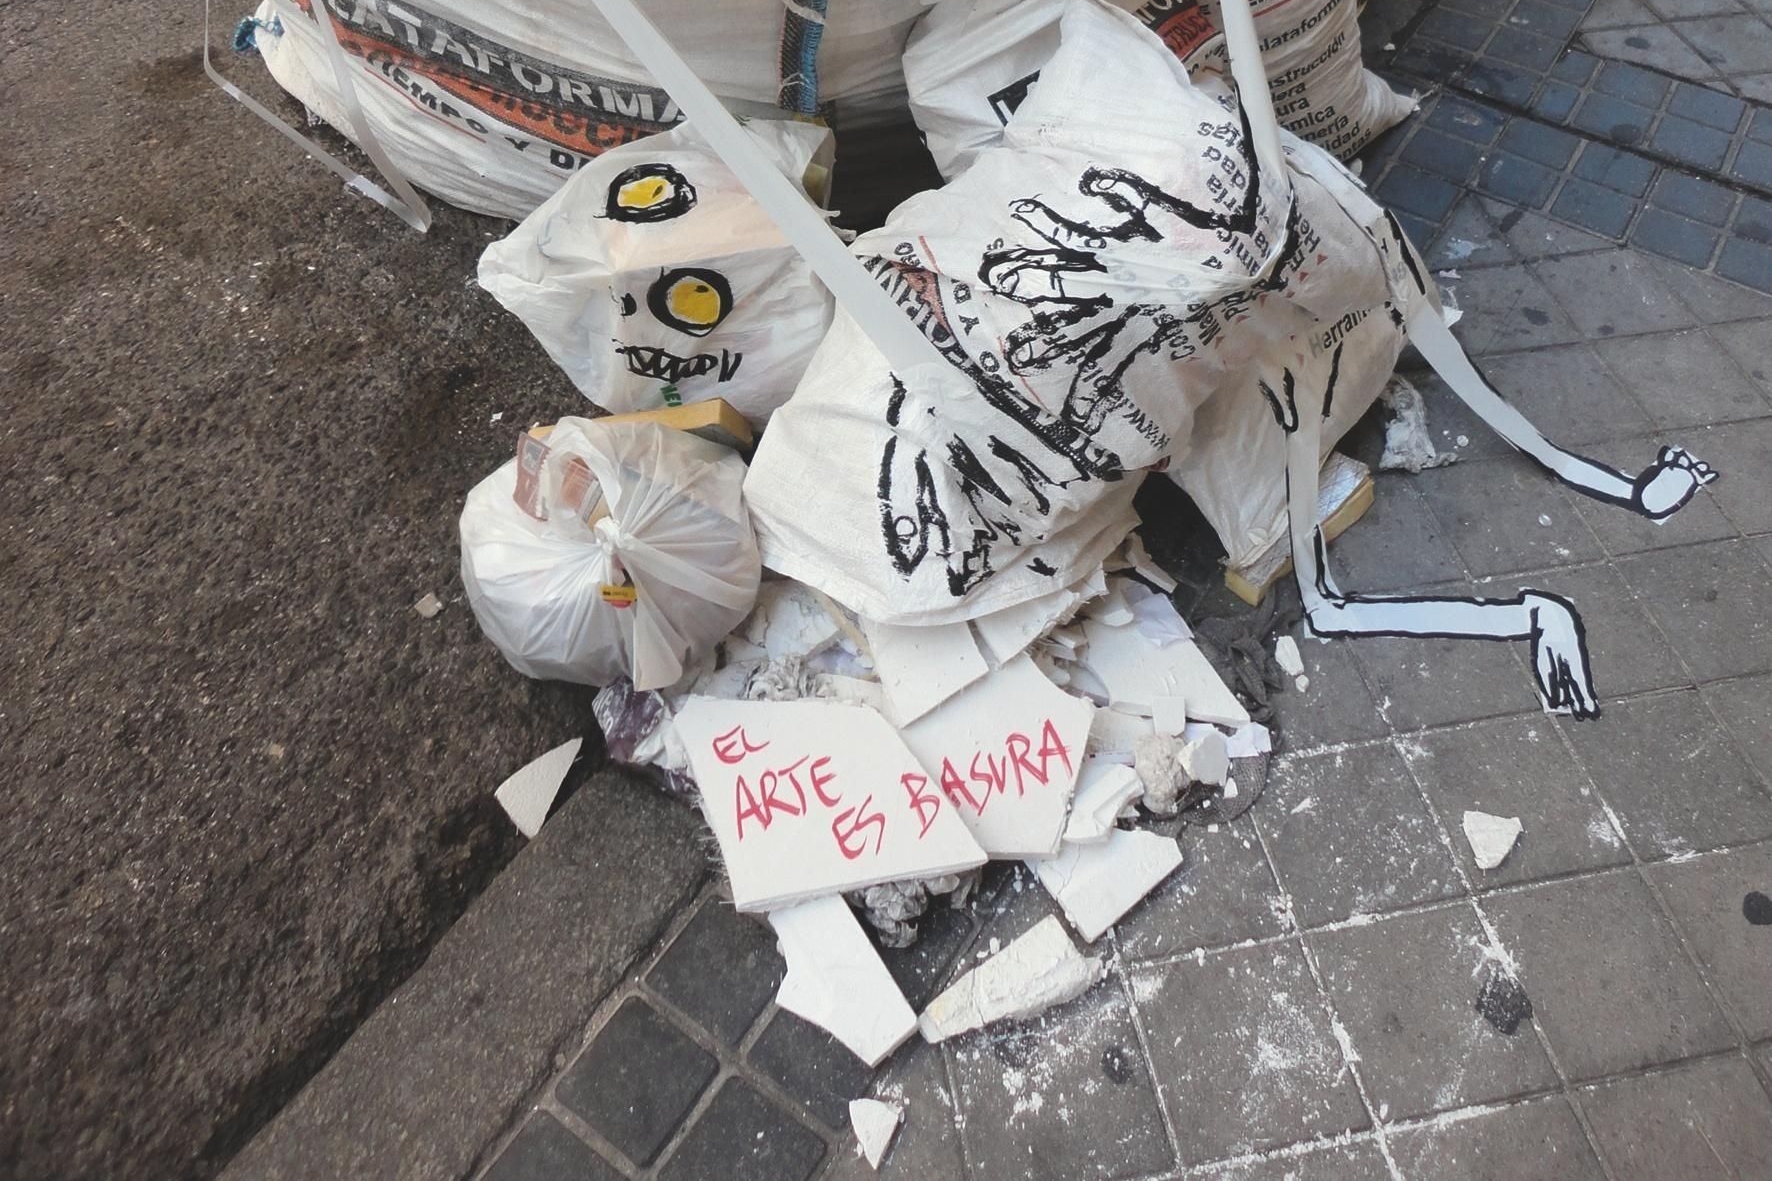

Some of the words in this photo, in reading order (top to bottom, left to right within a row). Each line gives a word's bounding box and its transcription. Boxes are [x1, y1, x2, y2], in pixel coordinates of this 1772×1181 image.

[505, 135, 530, 152] Y
[712, 723, 770, 765] EL
[734, 754, 843, 842] ARTE
[831, 793, 887, 861] ES
[900, 718, 1075, 842] BASURA
